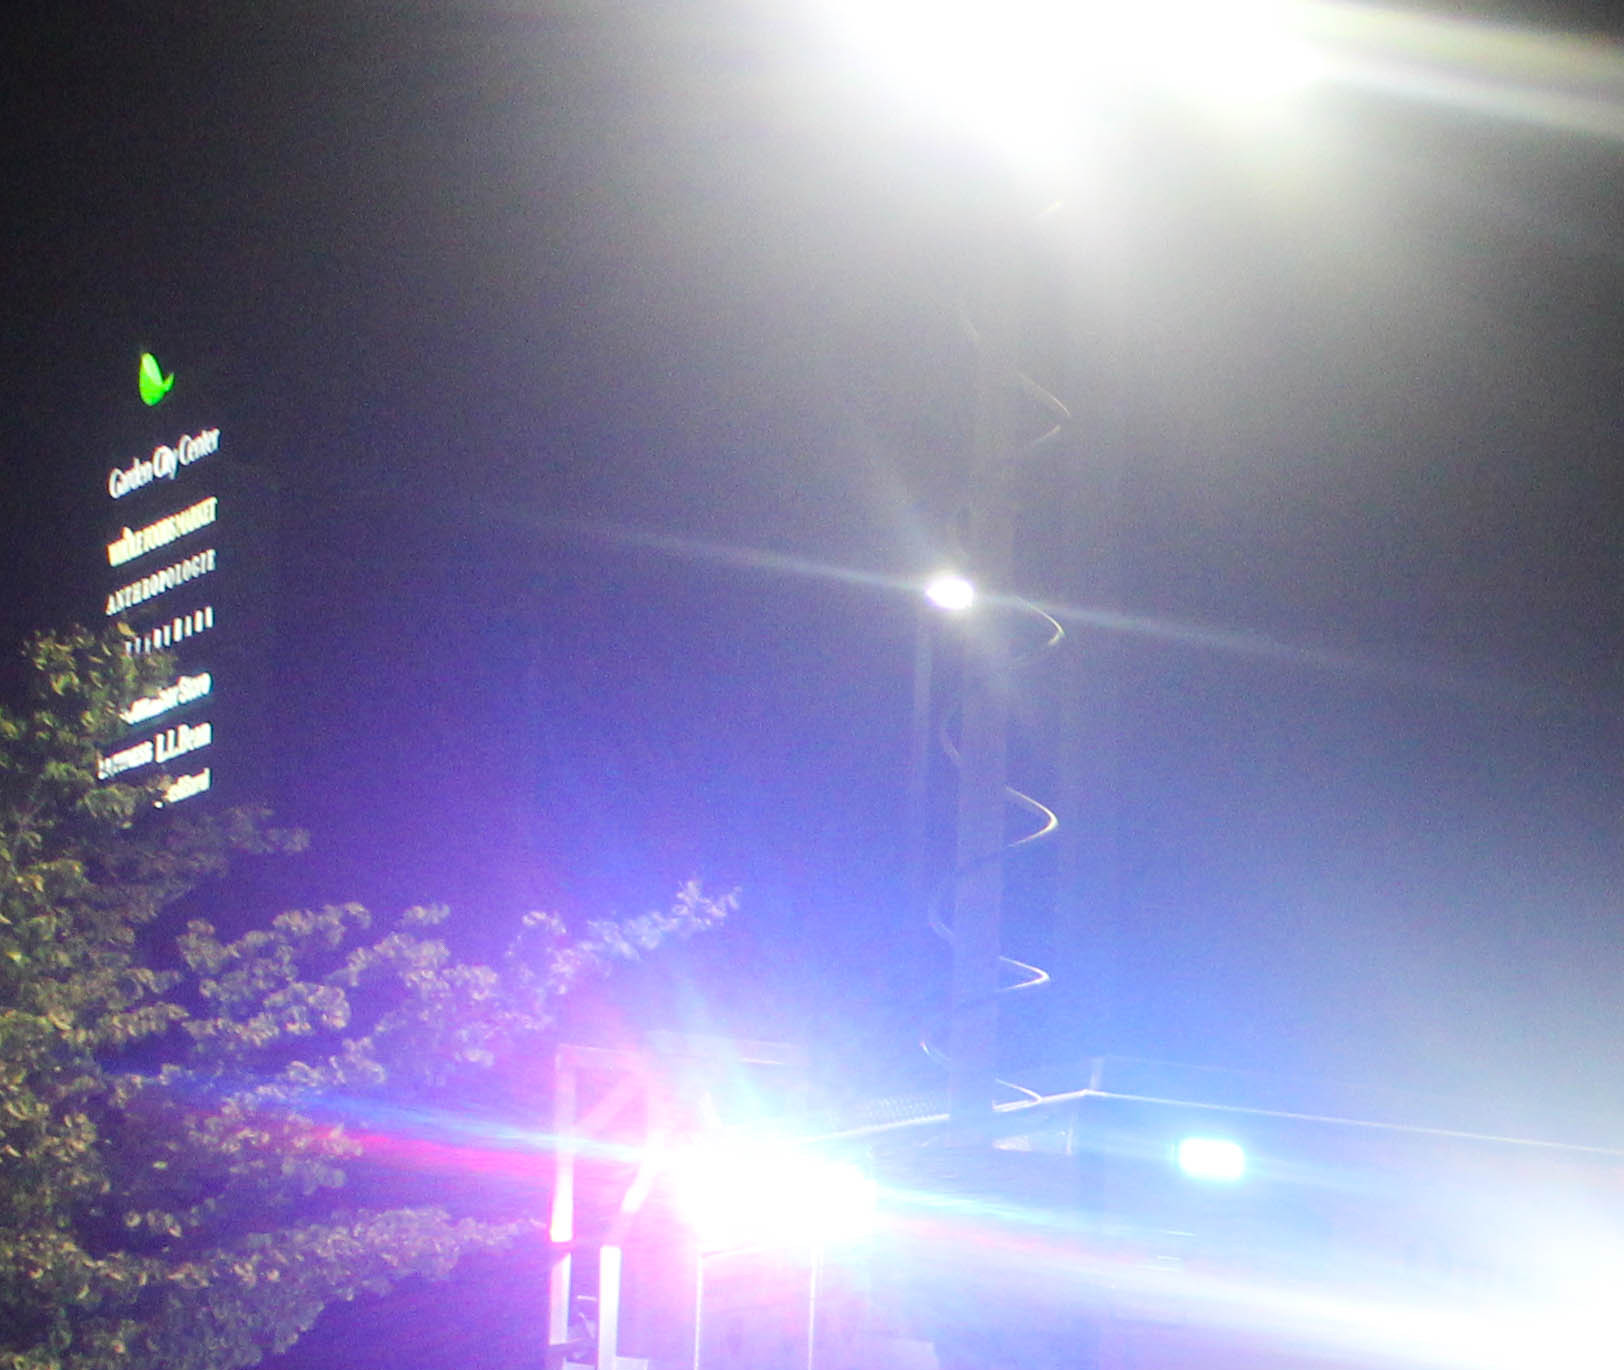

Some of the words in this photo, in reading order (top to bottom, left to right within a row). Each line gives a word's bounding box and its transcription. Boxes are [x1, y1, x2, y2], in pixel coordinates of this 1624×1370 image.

[107, 457, 154, 499] Garden
[153, 445, 179, 480] City
[178, 427, 221, 466] Center
[105, 548, 217, 616] ANTHROPOLOGIE
